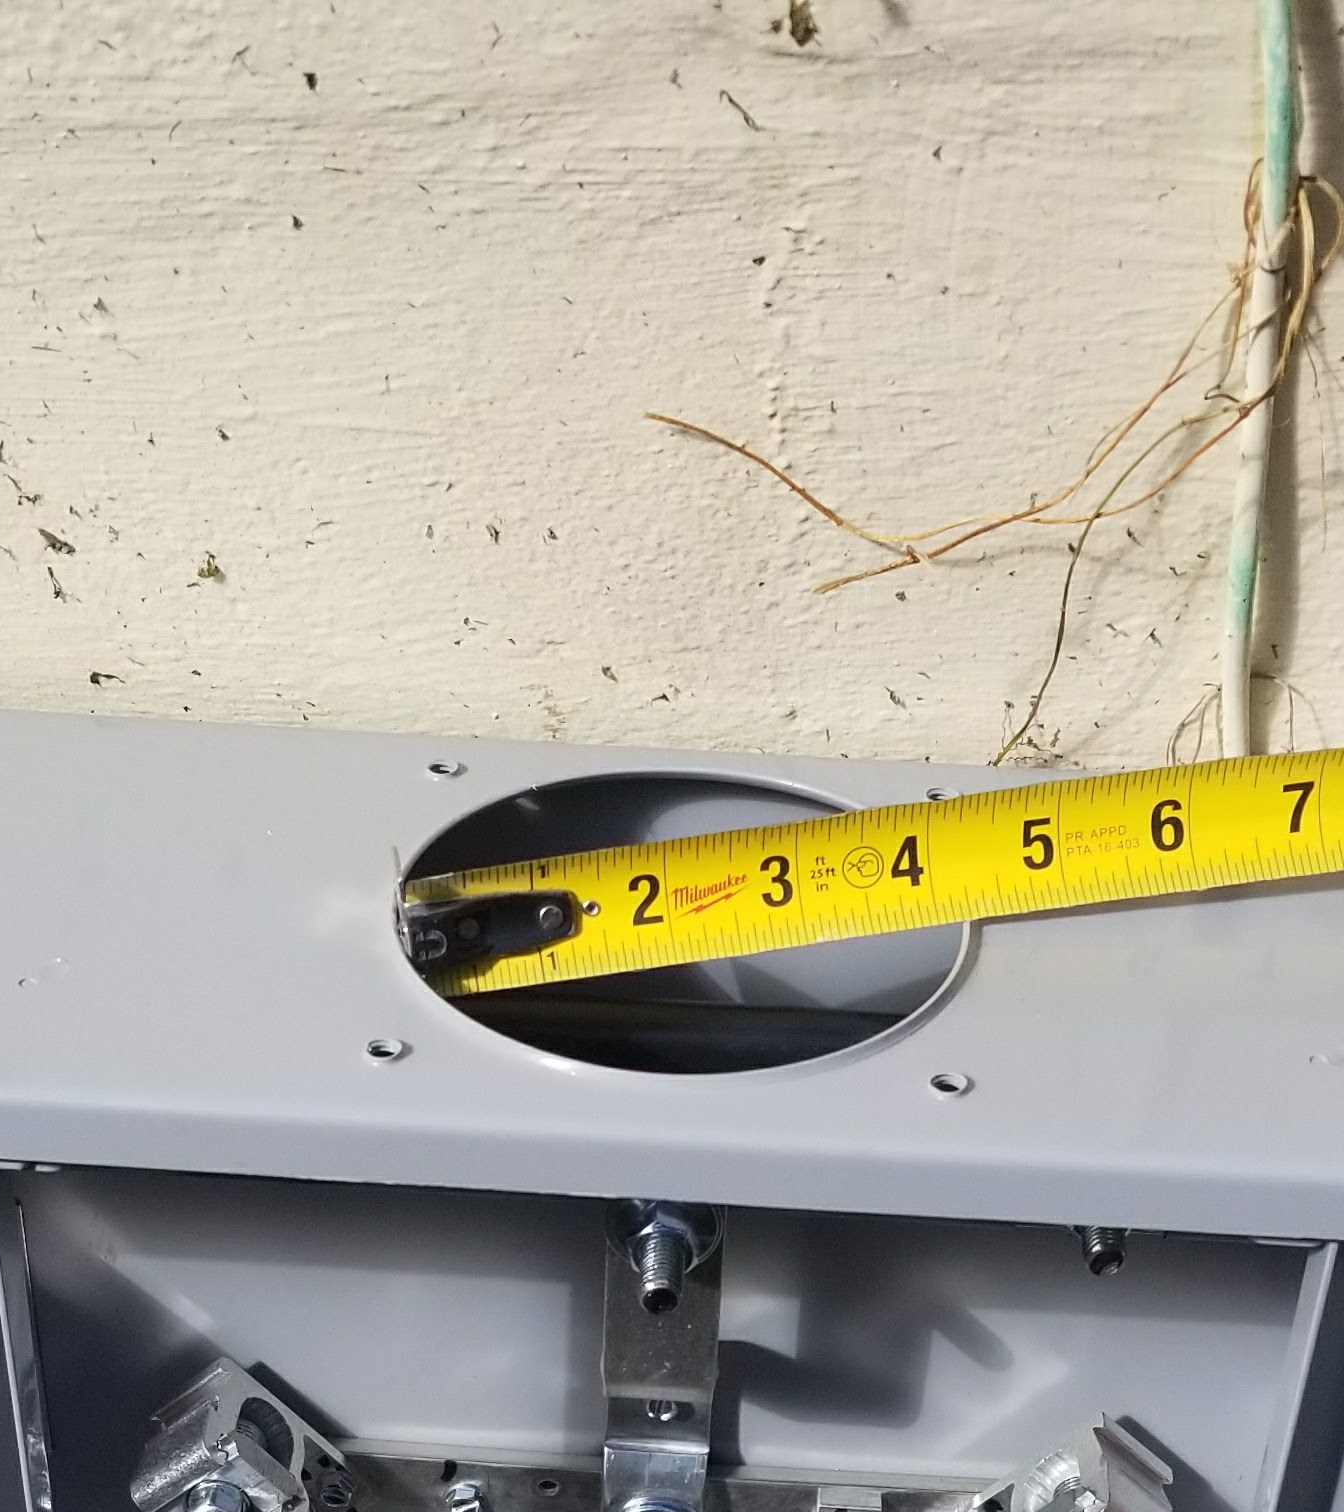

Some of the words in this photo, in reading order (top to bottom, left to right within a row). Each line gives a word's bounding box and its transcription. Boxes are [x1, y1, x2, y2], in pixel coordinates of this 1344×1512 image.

[629, 874, 664, 927] 2
[760, 854, 794, 909] 3
[891, 835, 924, 888] 4
[1022, 817, 1054, 871] 5
[1150, 799, 1186, 853] 6
[1281, 780, 1316, 834] 7
[670, 872, 750, 912] Milwaukee
[816, 882, 829, 892] in
